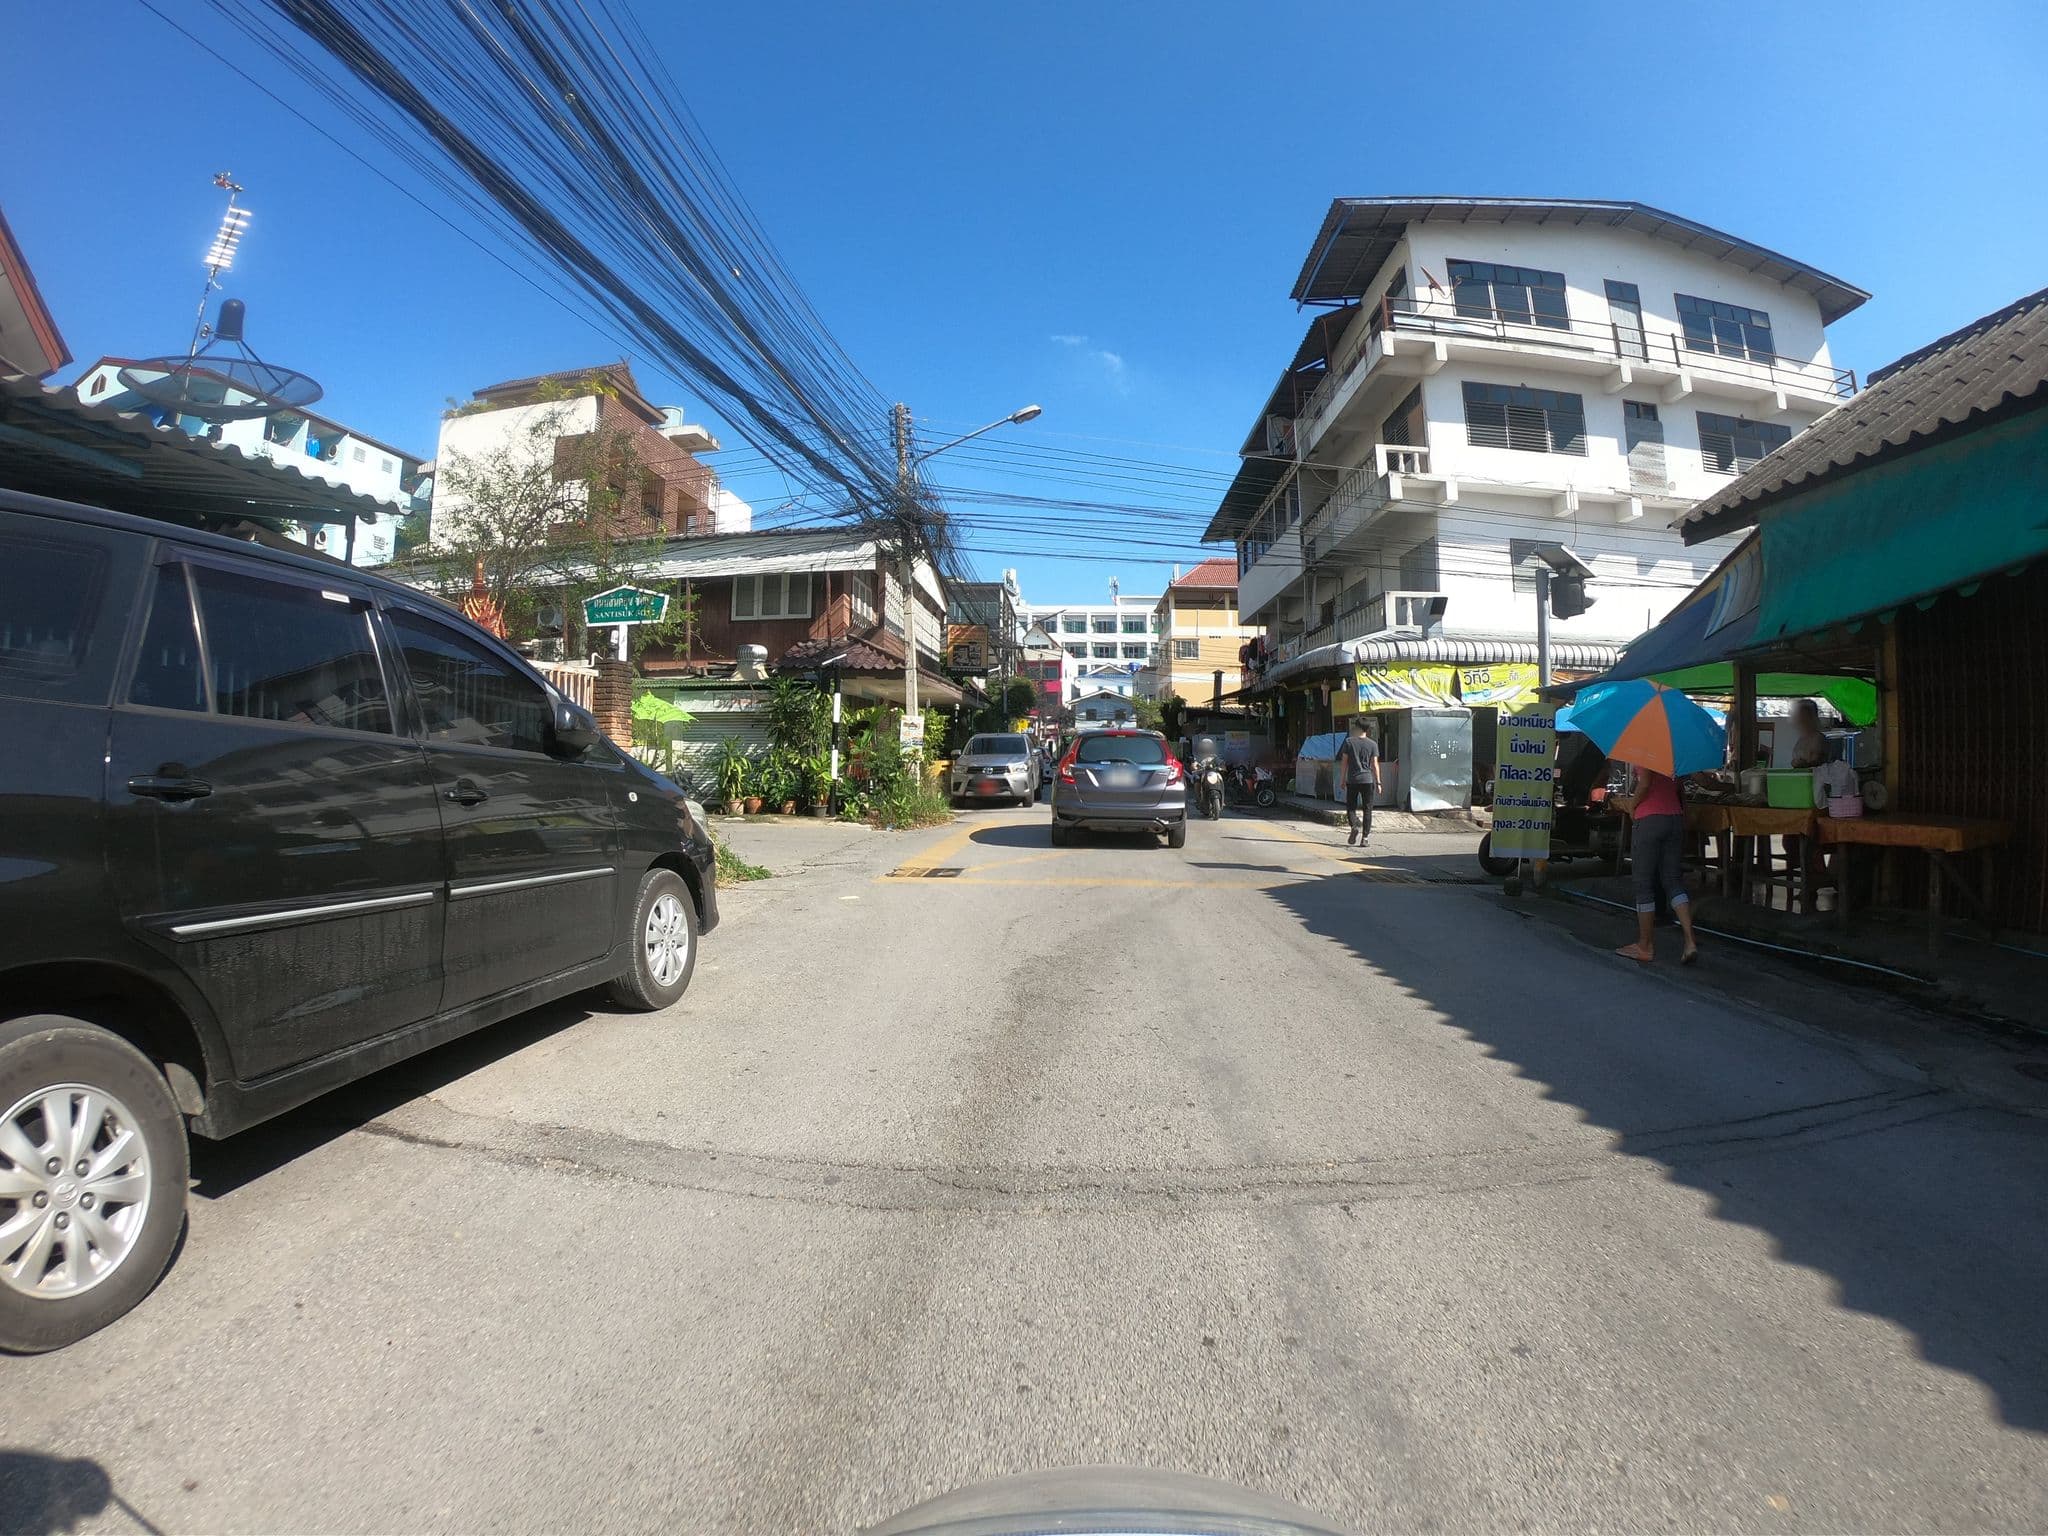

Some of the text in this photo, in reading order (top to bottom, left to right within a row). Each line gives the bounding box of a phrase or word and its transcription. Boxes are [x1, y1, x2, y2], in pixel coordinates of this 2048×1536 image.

[594, 610, 634, 619] SANTISUK
[1463, 668, 1490, 685] วีทีวี
[1499, 711, 1555, 728] ข้าวเหนียว
[1510, 733, 1546, 754] นึ่งใหม่
[1499, 764, 1552, 781] กิโลละ 26
[1495, 792, 1552, 808] กับข้าวพื้นเมือง
[1493, 819, 1551, 832] ถุงละ 20 บาท
